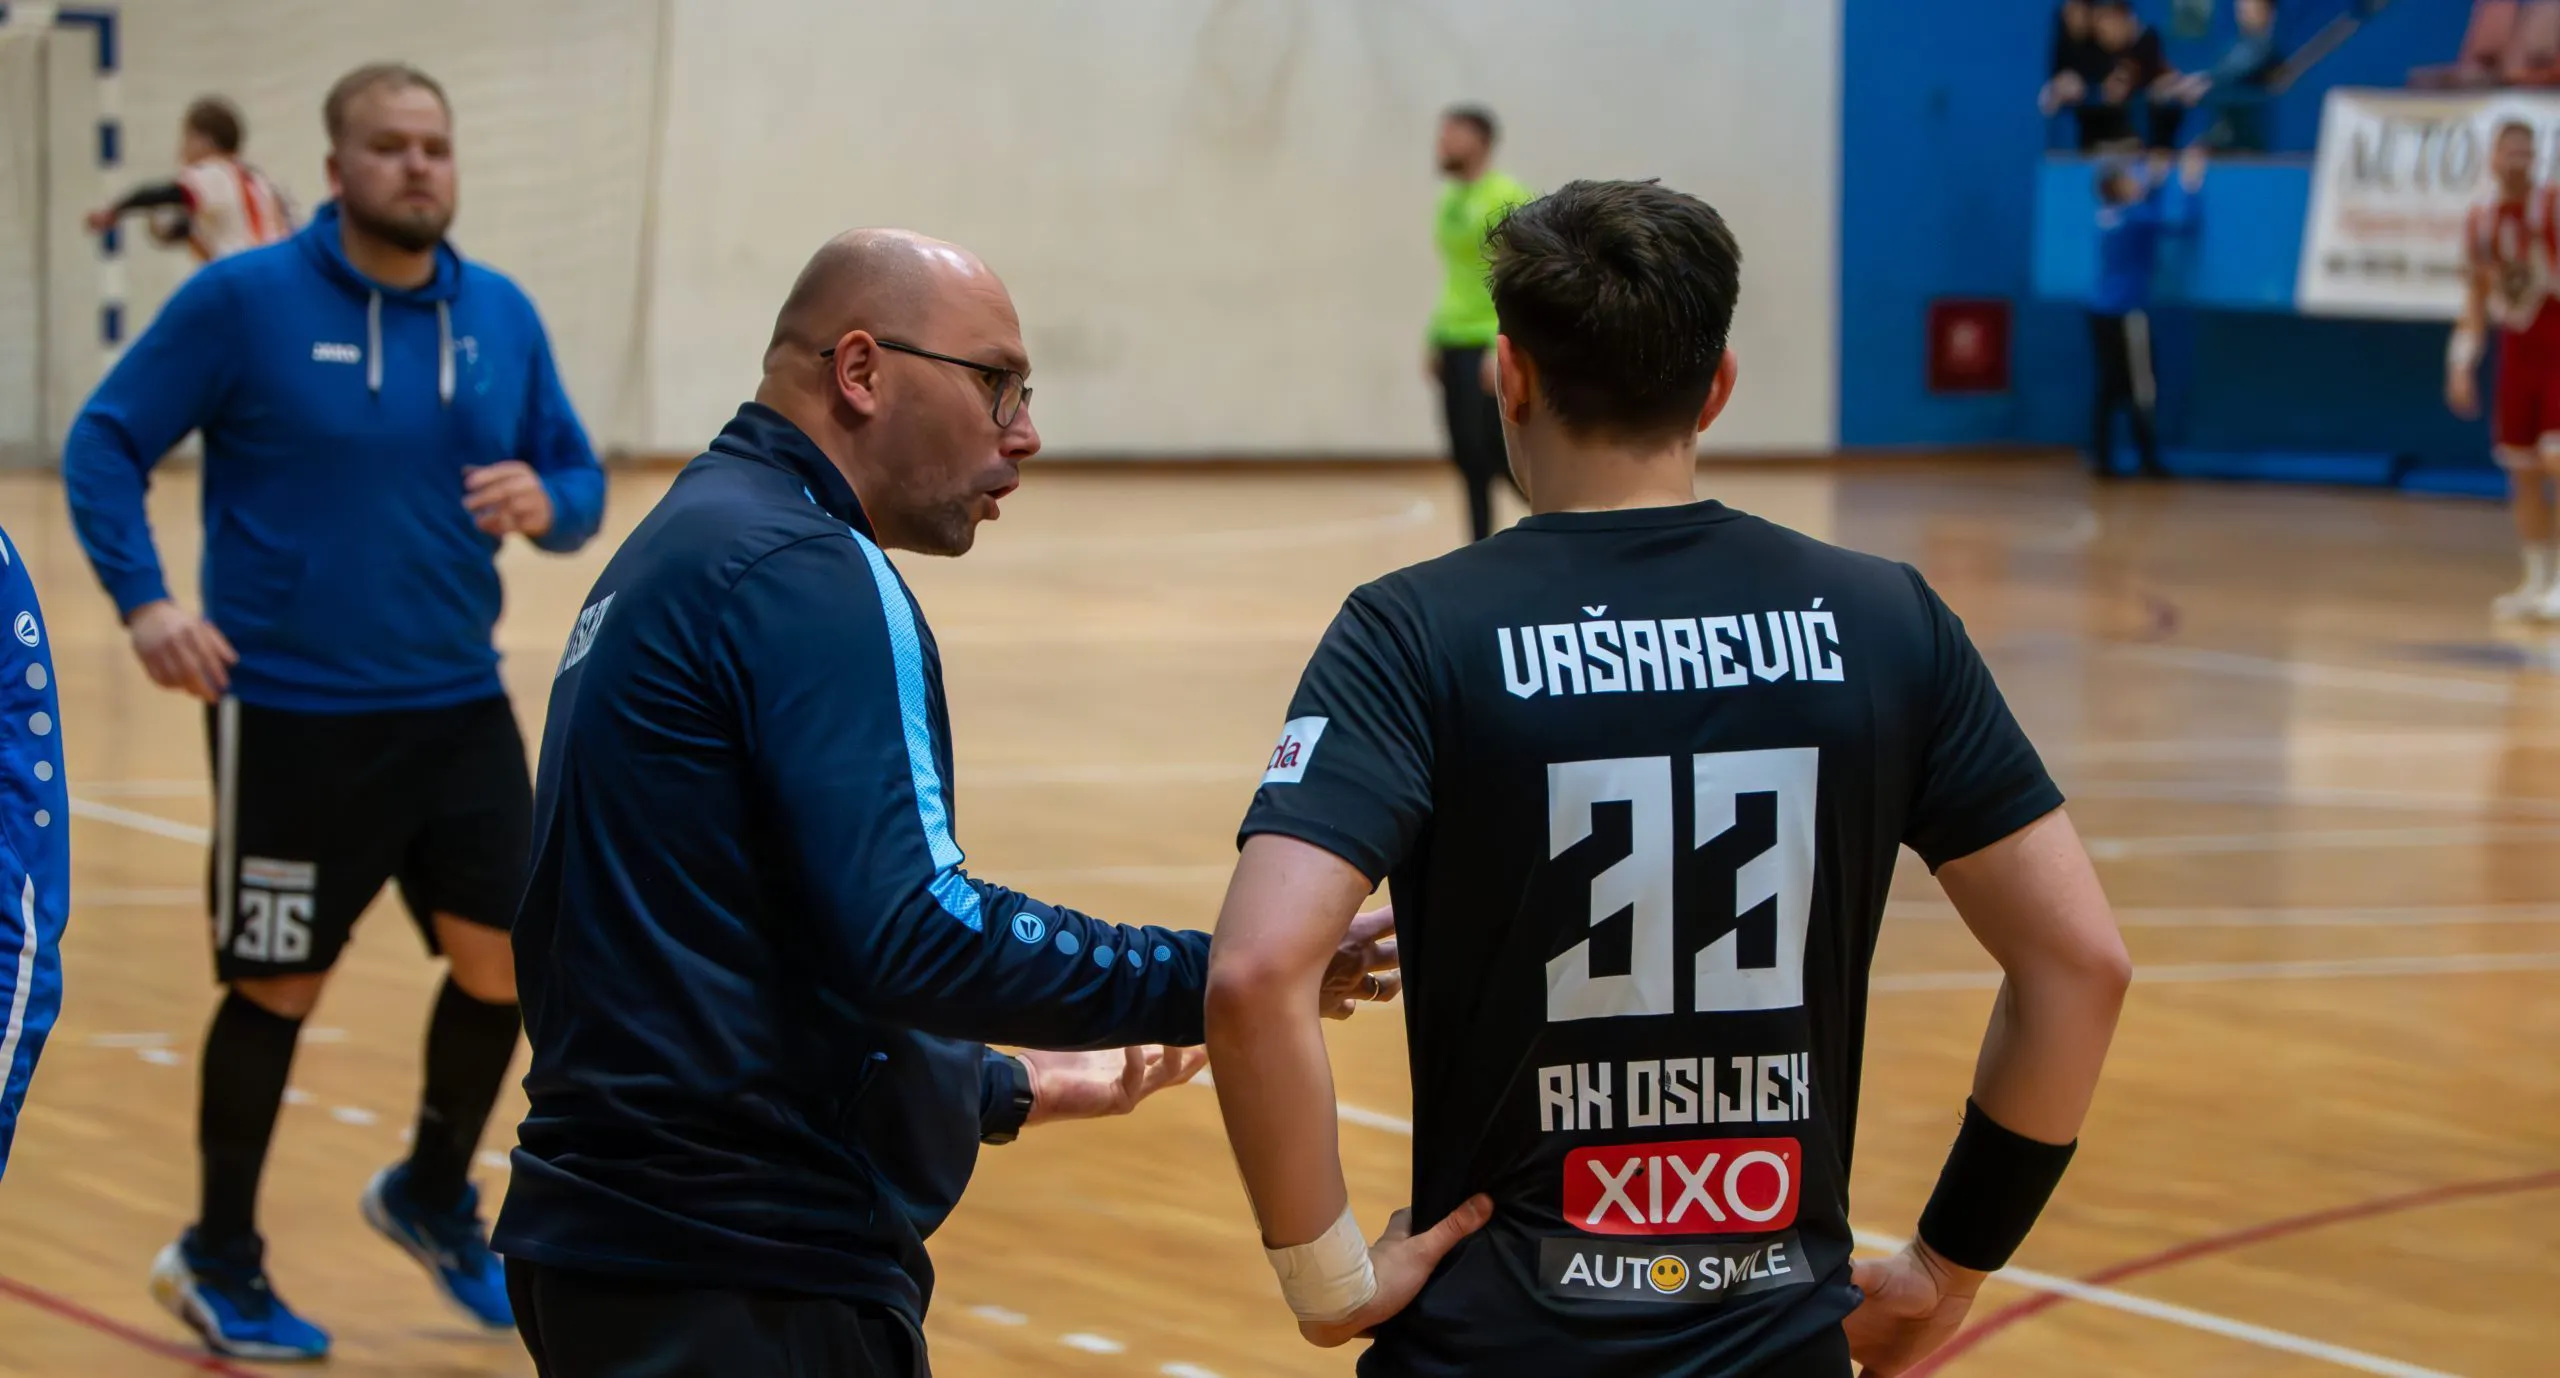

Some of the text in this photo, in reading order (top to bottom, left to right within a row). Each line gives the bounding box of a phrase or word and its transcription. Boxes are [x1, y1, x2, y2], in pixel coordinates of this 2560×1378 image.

[1497, 597, 1845, 699] VAŠAREVIĆ
[1546, 746, 1820, 1022] 33
[233, 889, 314, 962] 36
[1538, 1051, 1811, 1132] RK OSIJEK
[1586, 1150, 1790, 1225] XIXO
[1698, 1242, 1791, 1290] SMILE
